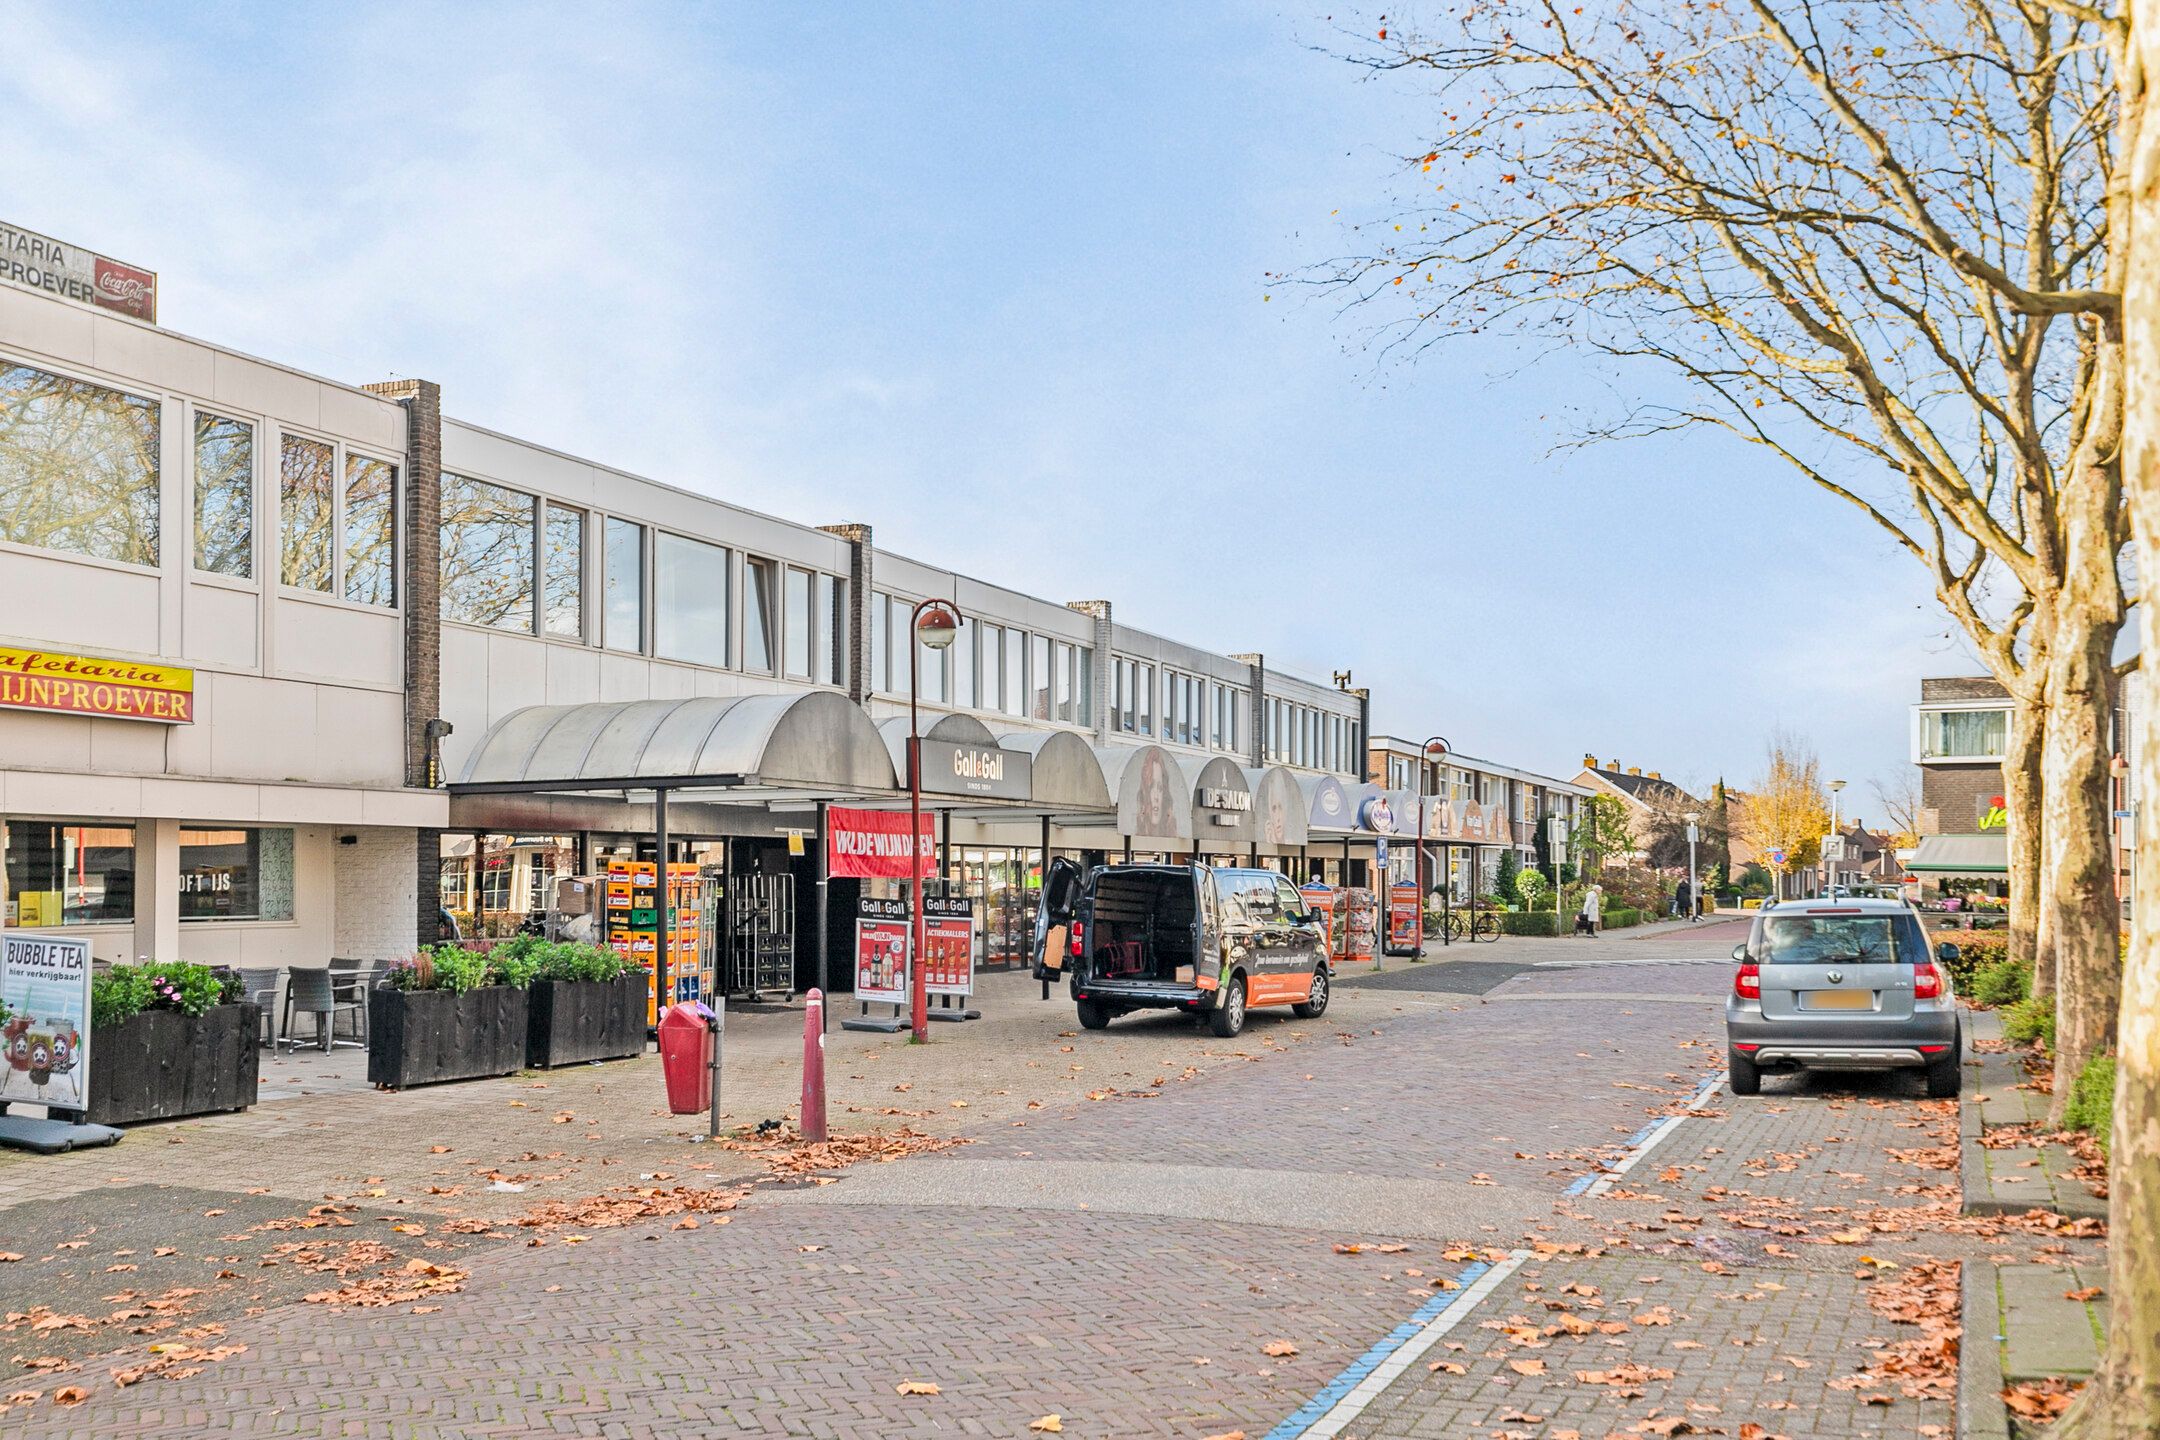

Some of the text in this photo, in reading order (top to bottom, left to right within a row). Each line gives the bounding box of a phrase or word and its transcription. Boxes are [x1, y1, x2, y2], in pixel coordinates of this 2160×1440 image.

[0, 257, 94, 304] PROEVER
[0, 653, 165, 683] afetaria
[2, 675, 188, 718] IJNPROEVER
[901, 834, 934, 857] DEN
[212, 872, 231, 891] IJS
[7, 942, 84, 970] BUBBLE TEA
[8, 967, 82, 982] hier verkrijgbaar!
